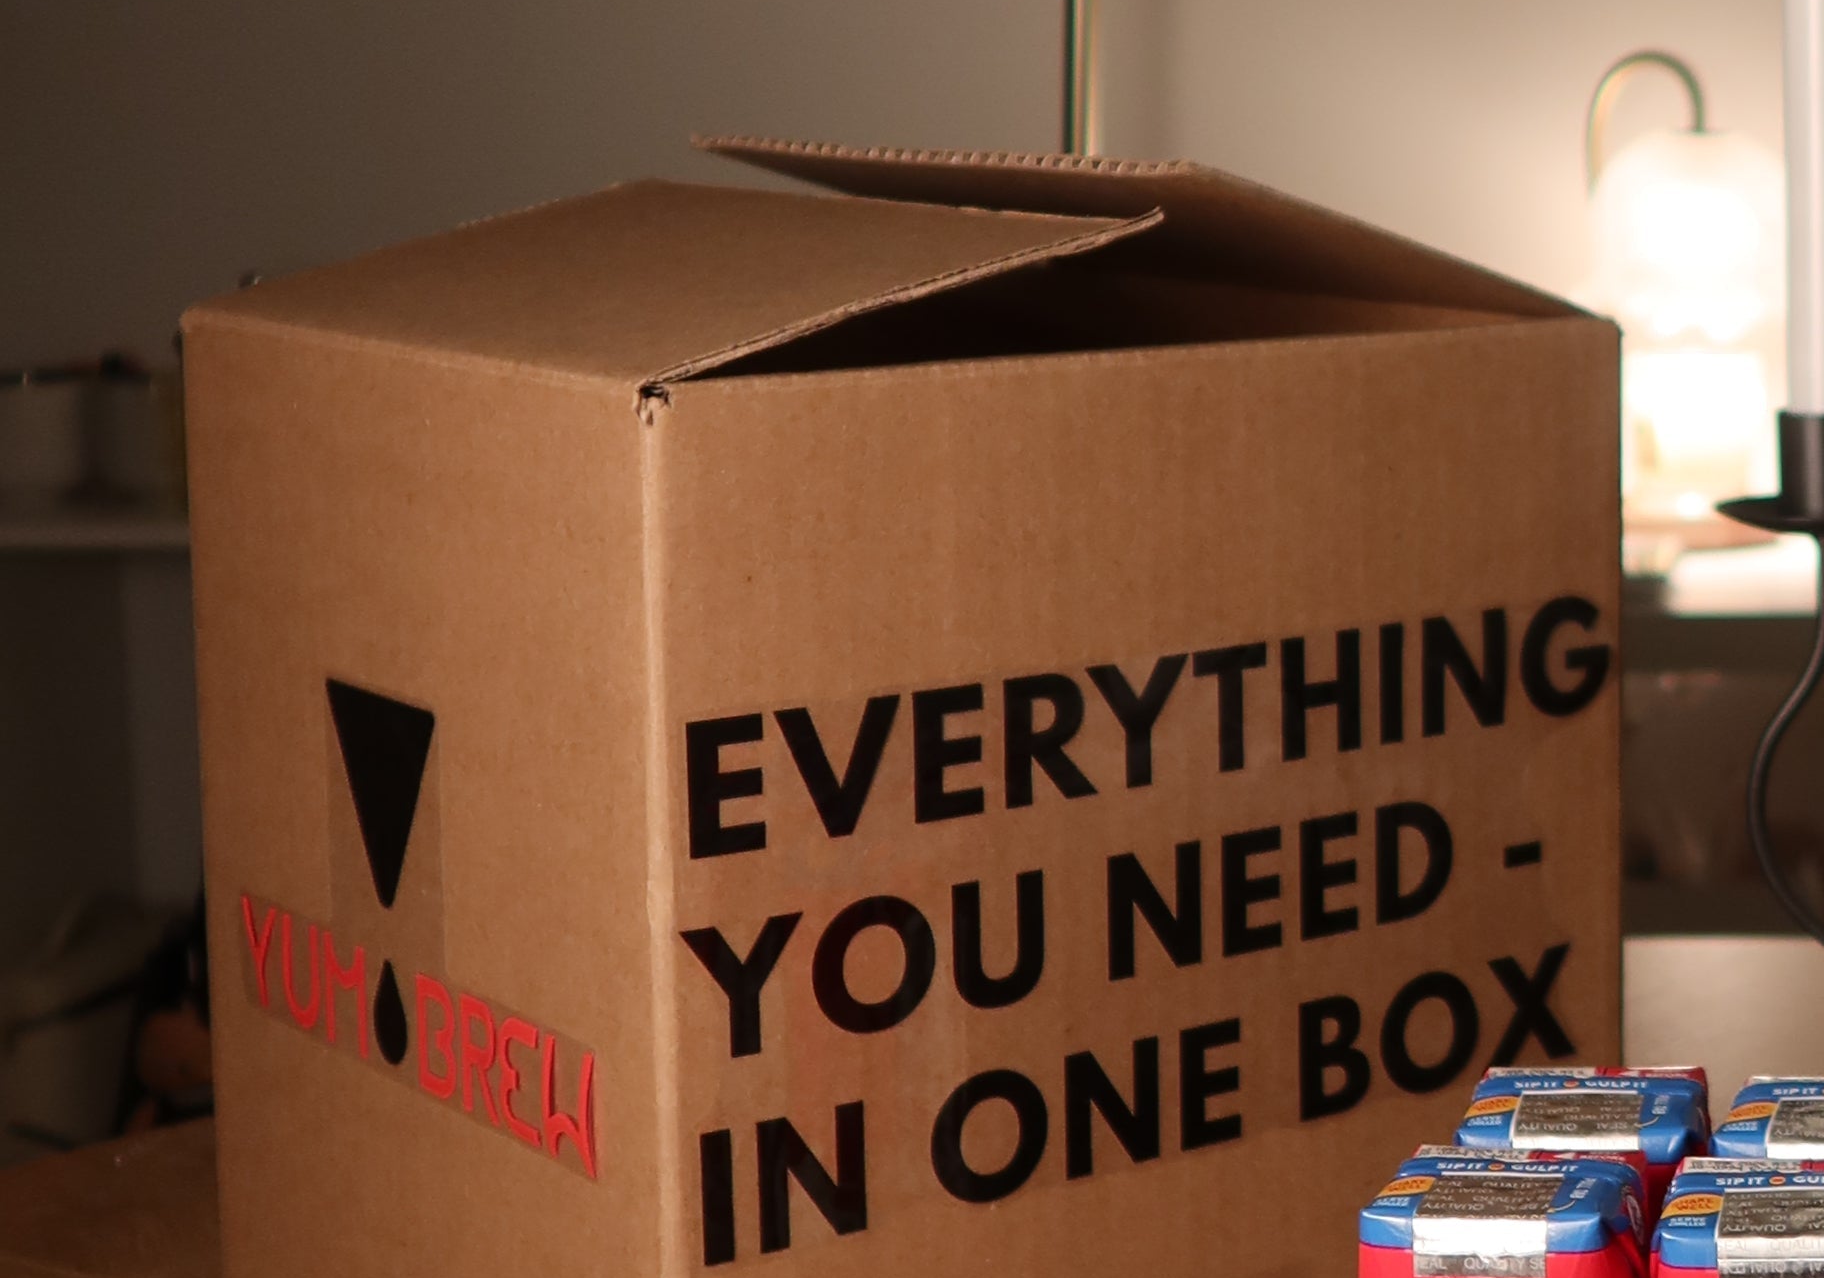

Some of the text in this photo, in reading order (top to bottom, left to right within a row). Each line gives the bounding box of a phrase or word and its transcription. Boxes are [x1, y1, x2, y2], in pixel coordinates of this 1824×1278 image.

[685, 595, 1611, 860] EVERYTHING
[680, 869, 1045, 1060] YOU
[1106, 800, 1454, 982] NEED
[702, 943, 1575, 1267] IN ONE BOX
[1436, 1162, 1465, 1170] SIP
[1510, 1163, 1560, 1172] GULP
[1716, 1177, 1745, 1186] SIP
[1418, 1257, 1447, 1270] EAL
